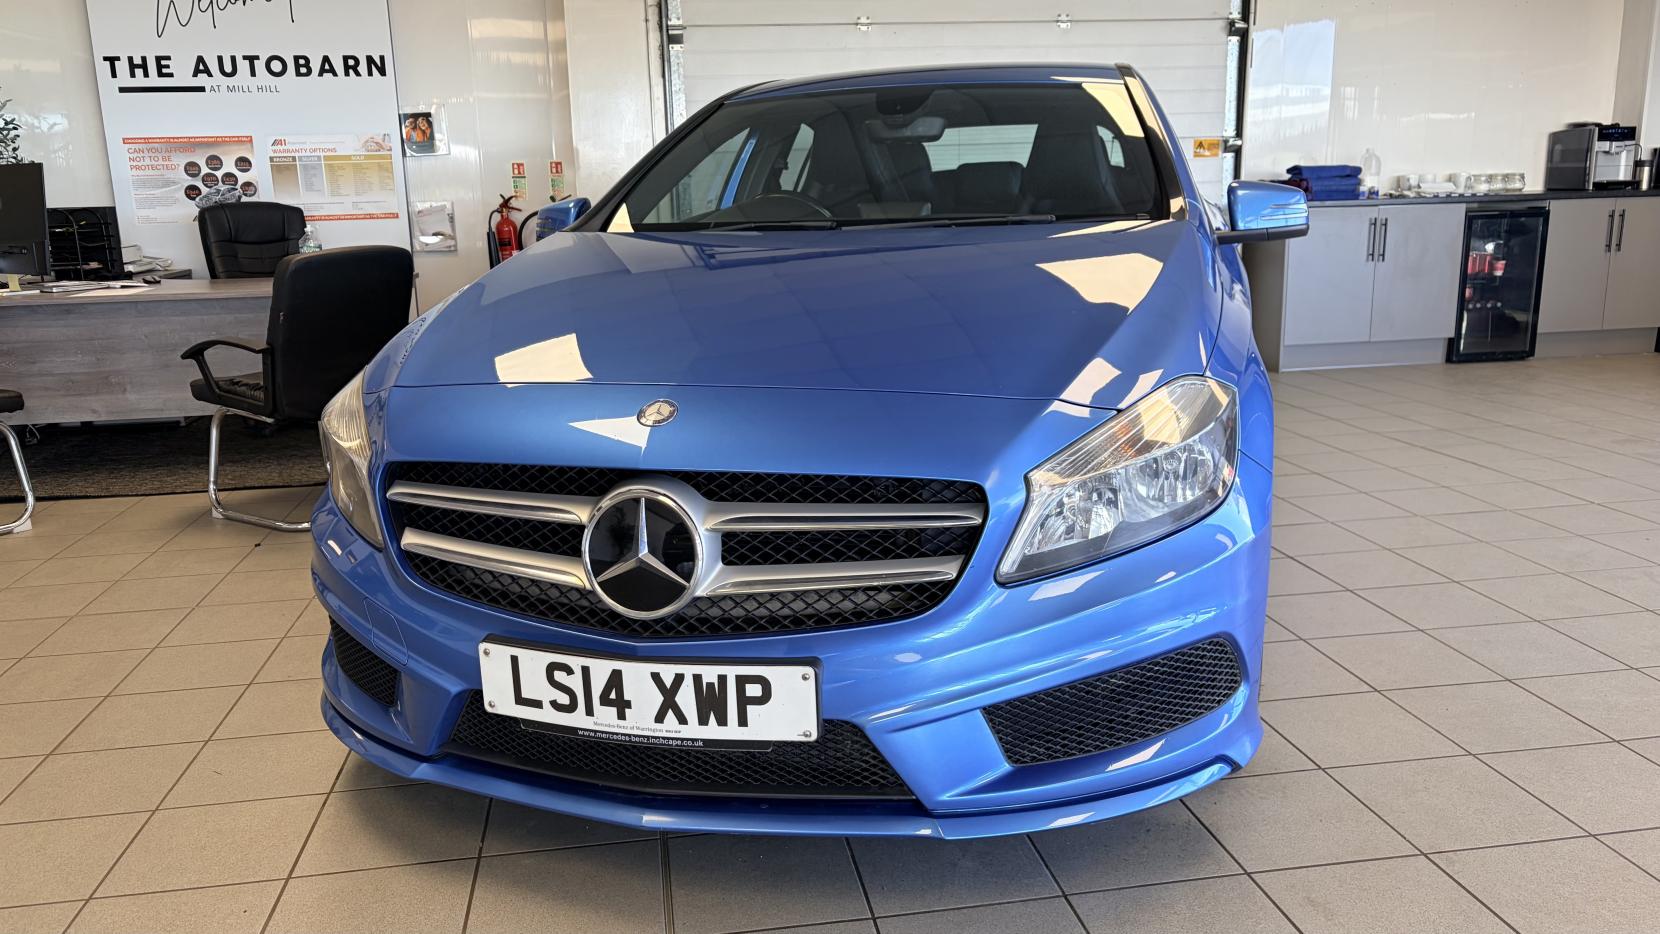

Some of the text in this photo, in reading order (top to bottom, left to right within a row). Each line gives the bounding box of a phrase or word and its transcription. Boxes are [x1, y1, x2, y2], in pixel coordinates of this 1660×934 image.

[102, 54, 388, 79] THE AUTOBARN
[209, 84, 281, 94] AT MILL HILL
[128, 155, 146, 163] NOT
[510, 654, 773, 728] LS14 XWP
[593, 720, 628, 731] Mercedes-Benz
[635, 725, 663, 734] Warrington
[577, 729, 704, 747] www.mercedes-benz.inchcape.co.uk
